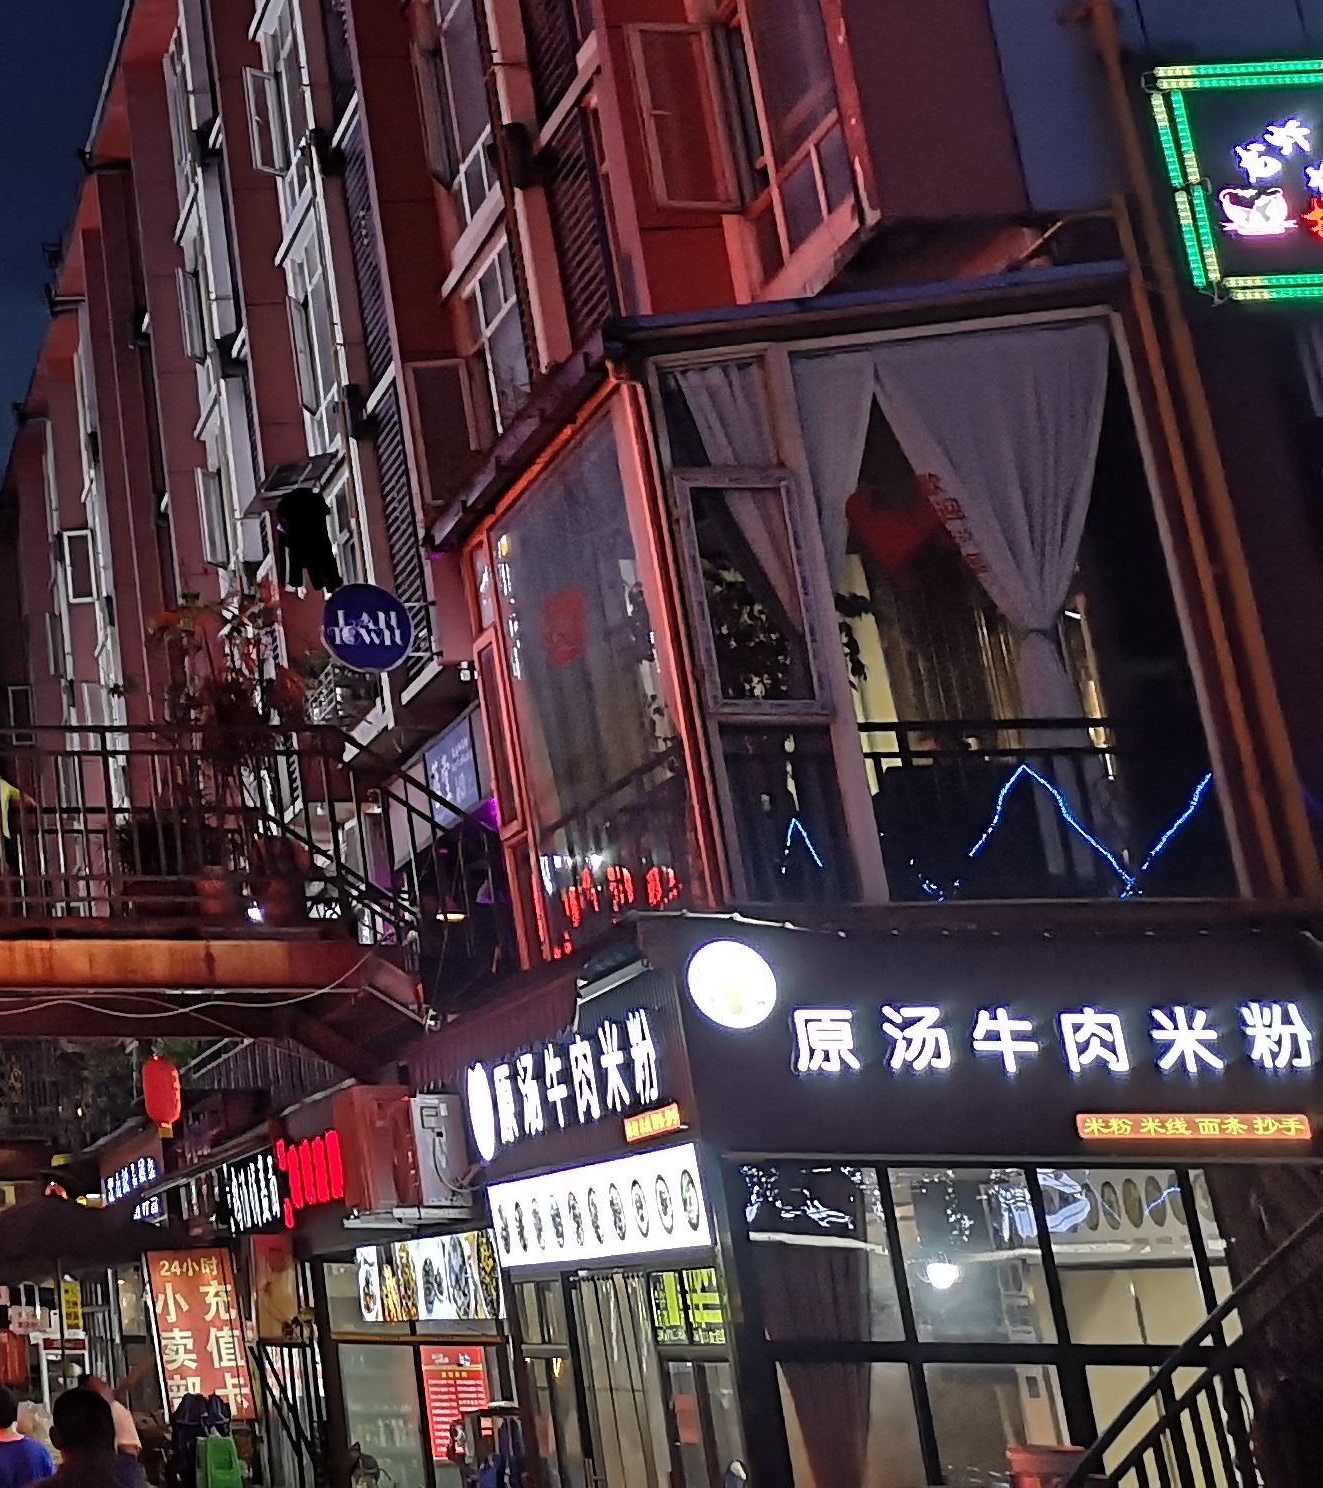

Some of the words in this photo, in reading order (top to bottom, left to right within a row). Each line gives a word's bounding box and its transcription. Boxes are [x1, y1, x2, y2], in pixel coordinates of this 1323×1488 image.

[792, 1001, 1319, 1074] 原汤牛肉米粉
[492, 1008, 659, 1143] 原汤牛肉米粉
[1084, 1116, 1132, 1136] 米粉
[1140, 1116, 1191, 1136] 米线
[1195, 1117, 1248, 1136] 面条
[1253, 1116, 1305, 1136] 抄手
[159, 1257, 220, 1277] 24小时
[199, 1280, 250, 1417] 充值卡
